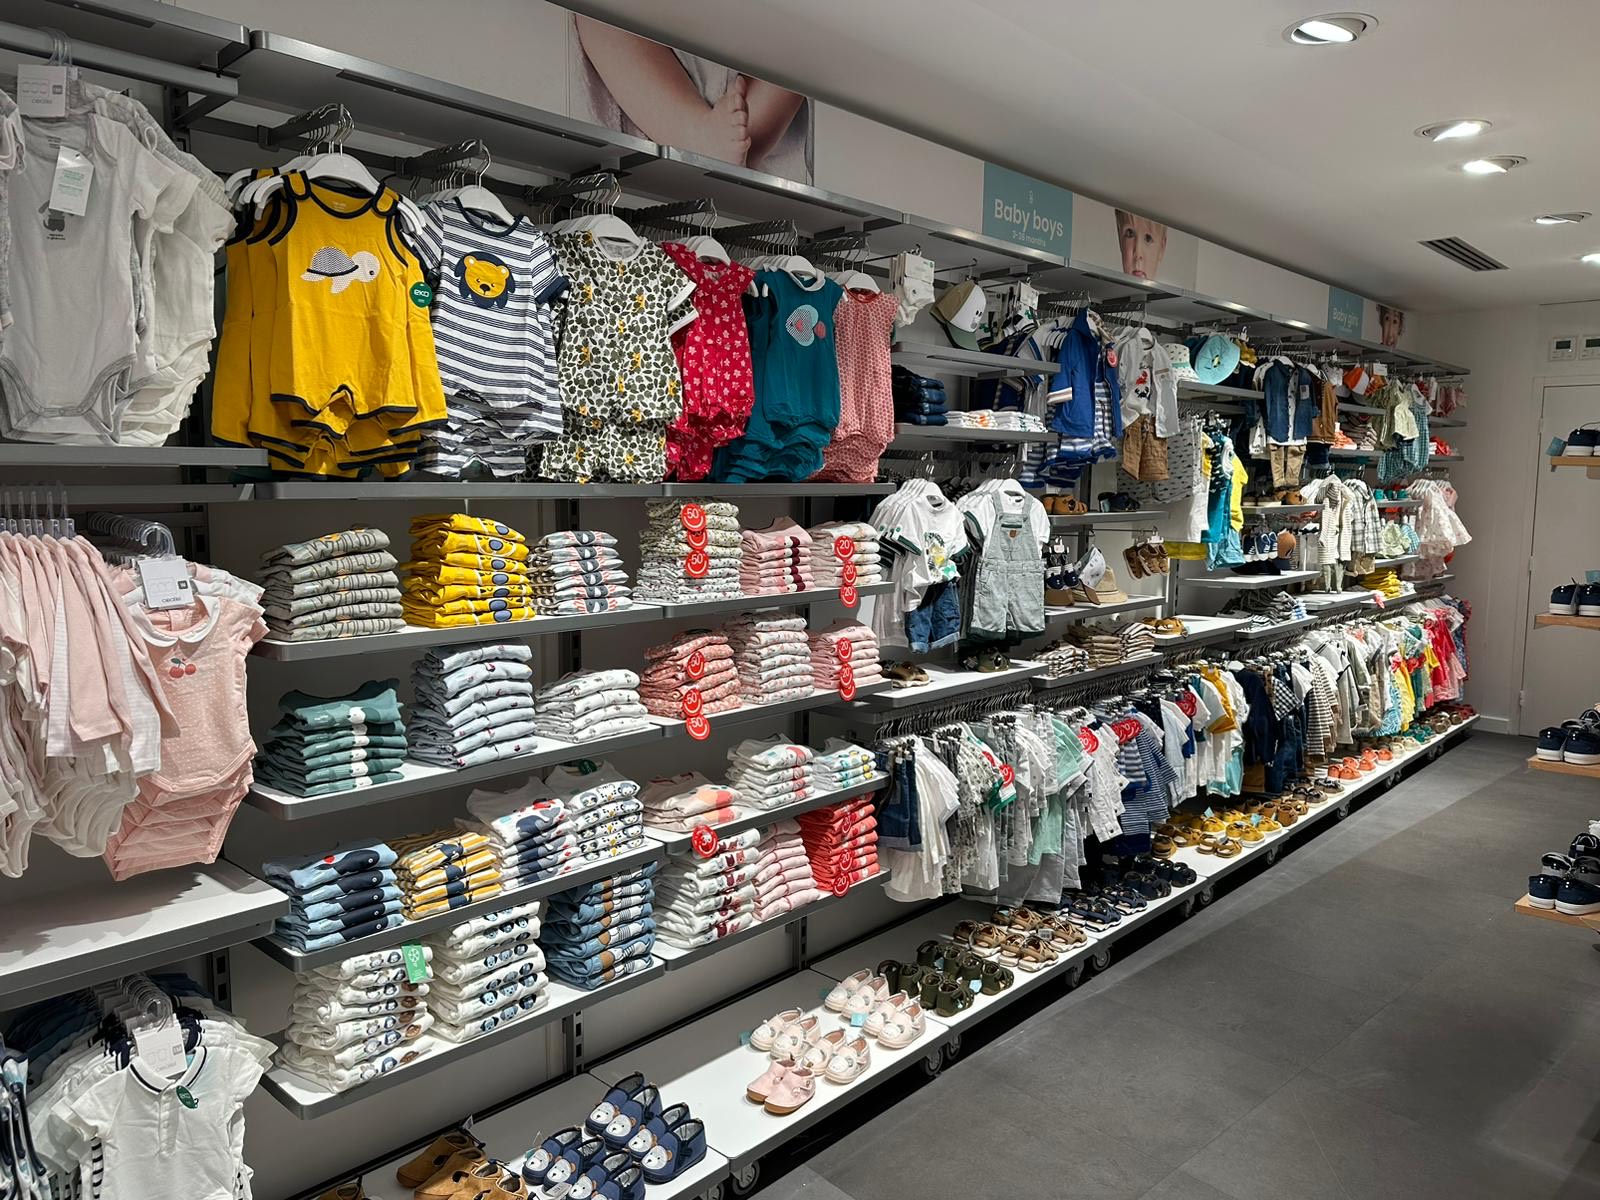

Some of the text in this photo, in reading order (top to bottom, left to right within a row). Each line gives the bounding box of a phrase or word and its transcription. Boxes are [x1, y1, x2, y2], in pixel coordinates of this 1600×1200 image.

[994, 198, 1063, 240] Baby boys
[306, 532, 377, 561] WILD
